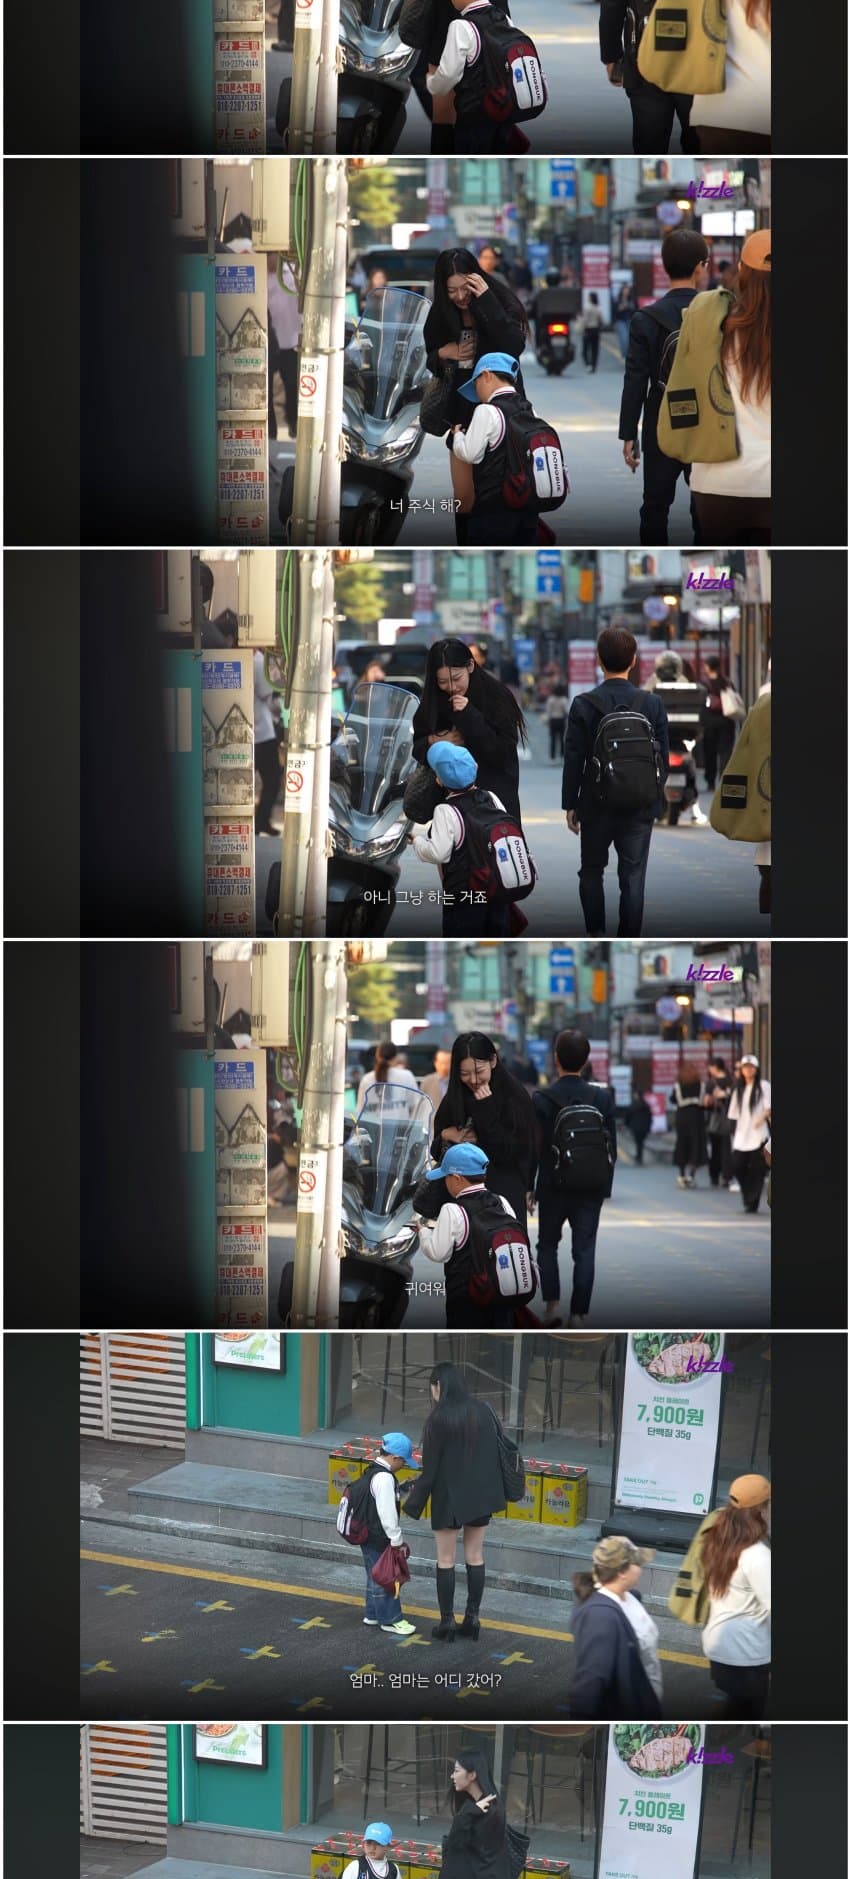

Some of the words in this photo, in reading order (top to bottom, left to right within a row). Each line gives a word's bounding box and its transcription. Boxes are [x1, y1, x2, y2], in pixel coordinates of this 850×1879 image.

[528, 60, 541, 102] DONGBUK
[552, 451, 561, 492] DONGBUK
[514, 839, 528, 881] DONGBUK
[517, 1247, 527, 1289] DONGBUK
[637, 1403, 704, 1427] 7,900원
[647, 1426, 673, 1438] 단백질
[675, 1429, 691, 1440] 35g
[619, 1798, 686, 1821] 7,900원
[629, 1820, 654, 1832] 단백질
[657, 1823, 672, 1835] 35g
